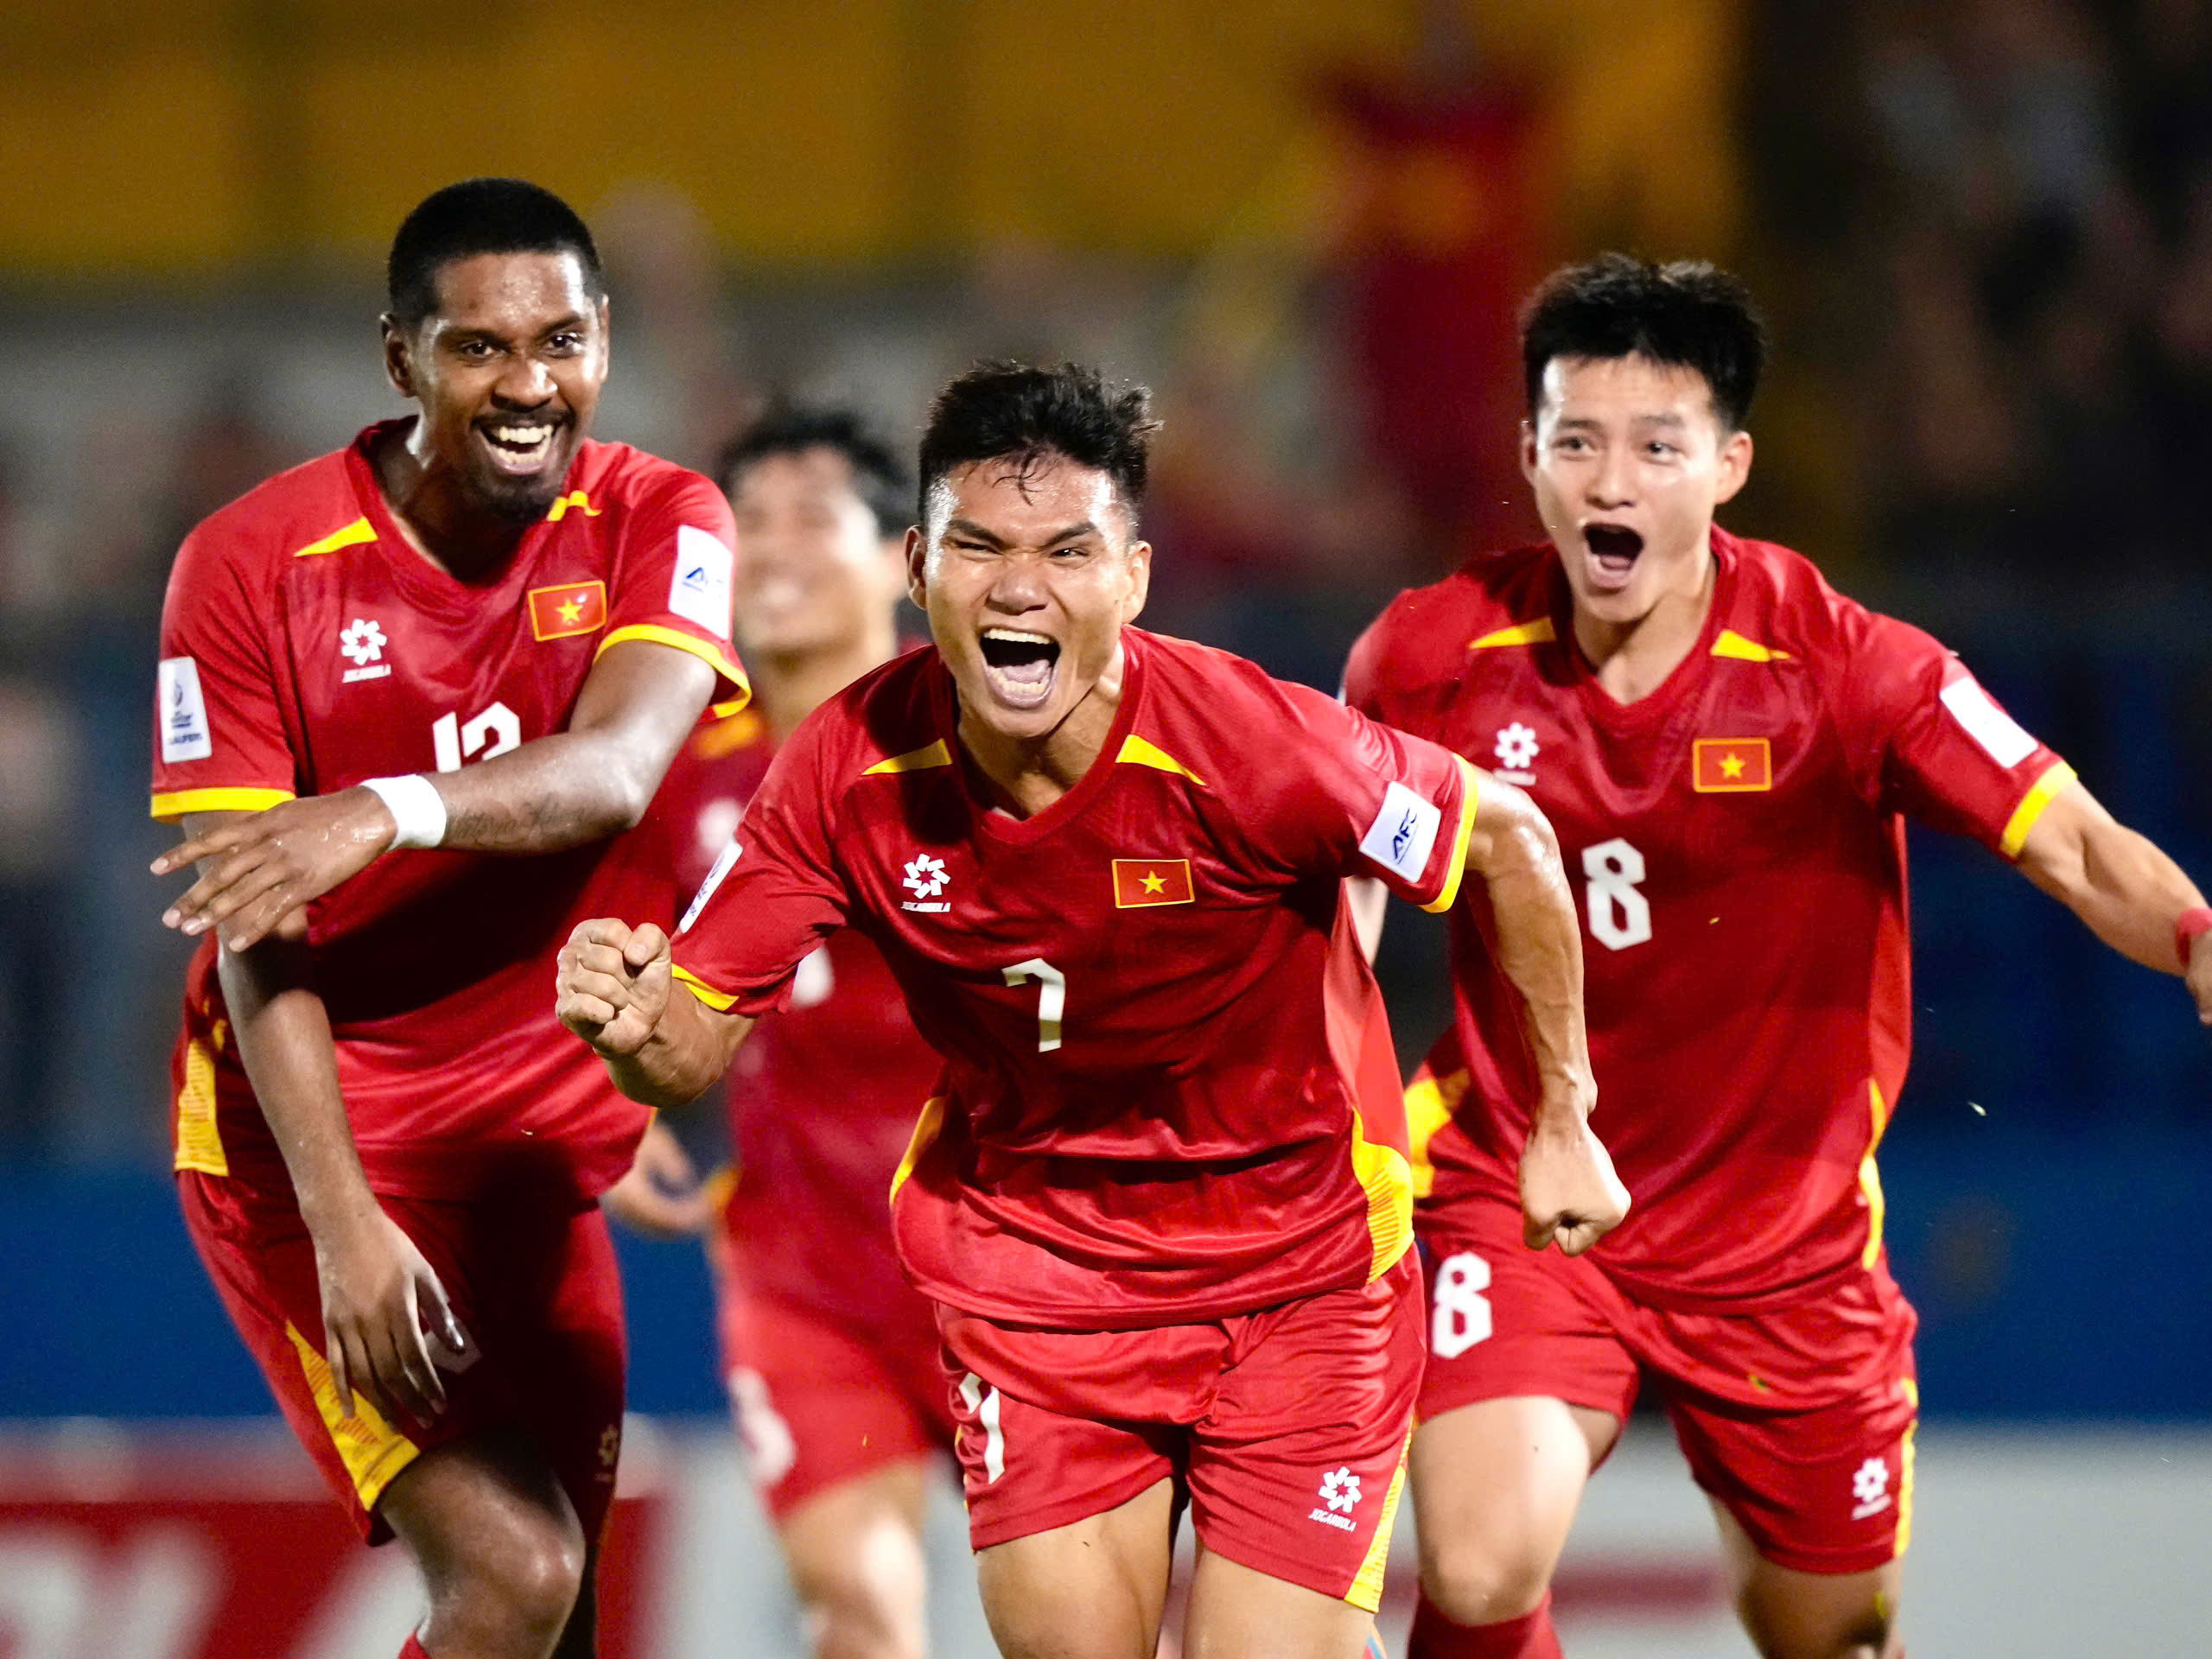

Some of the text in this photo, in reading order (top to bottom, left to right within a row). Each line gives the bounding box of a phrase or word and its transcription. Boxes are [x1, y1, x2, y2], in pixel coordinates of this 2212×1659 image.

[1581, 837, 1652, 951] 8
[1001, 957, 1066, 1052] 7
[1432, 1251, 1493, 1359] 8
[958, 1371, 1005, 1484] 7
